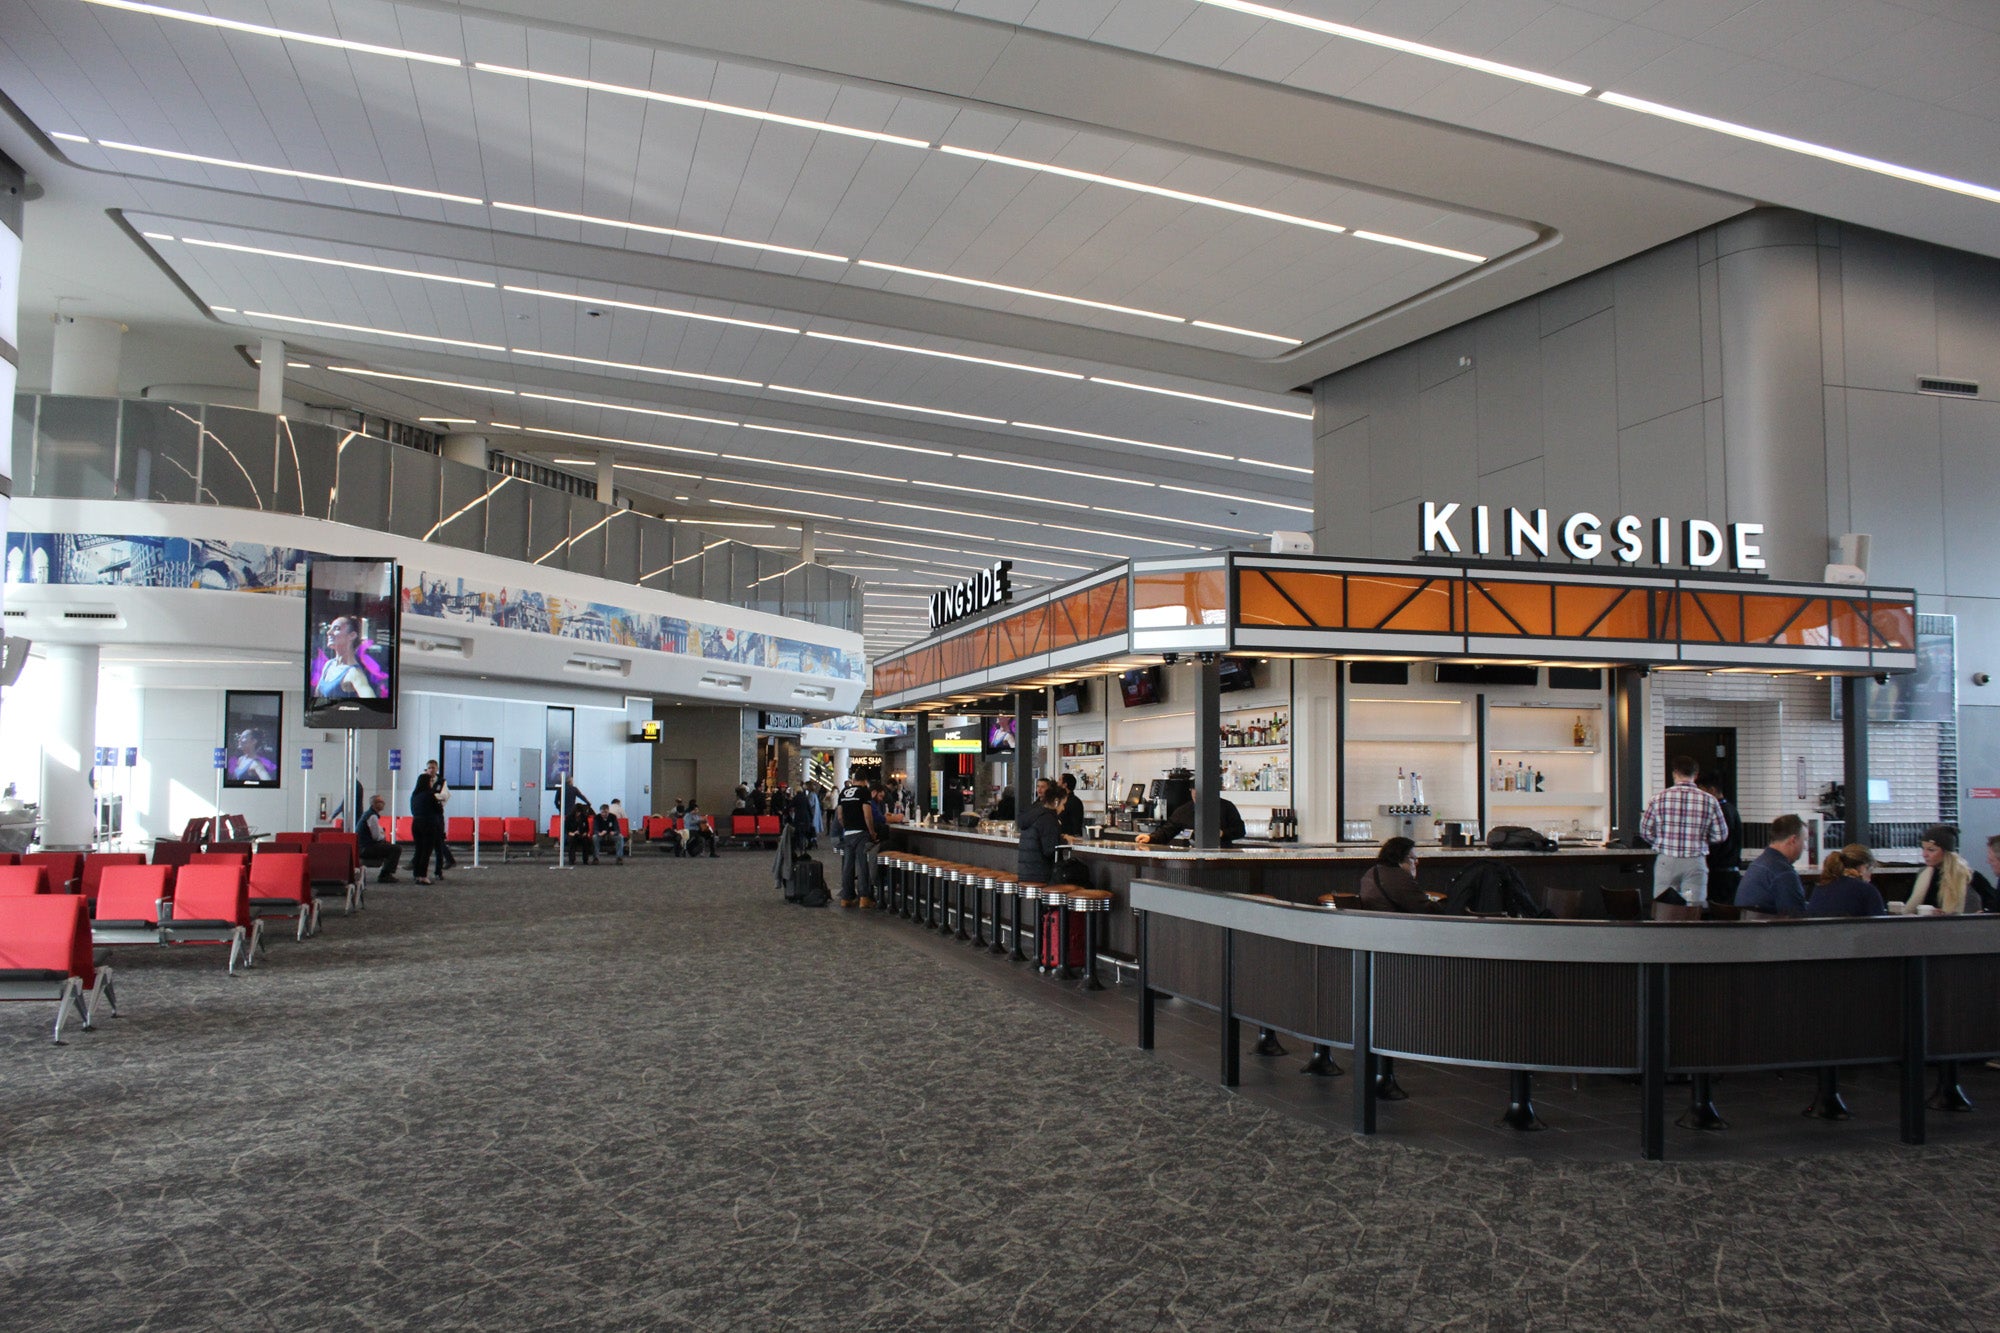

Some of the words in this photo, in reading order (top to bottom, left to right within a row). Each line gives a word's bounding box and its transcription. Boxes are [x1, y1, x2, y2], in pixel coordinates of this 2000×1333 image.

[1421, 501, 1766, 570] KINGSIDE
[928, 560, 1004, 629] KINGSIDE
[851, 756, 868, 765] HAKE
[868, 756, 882, 765] SHA
